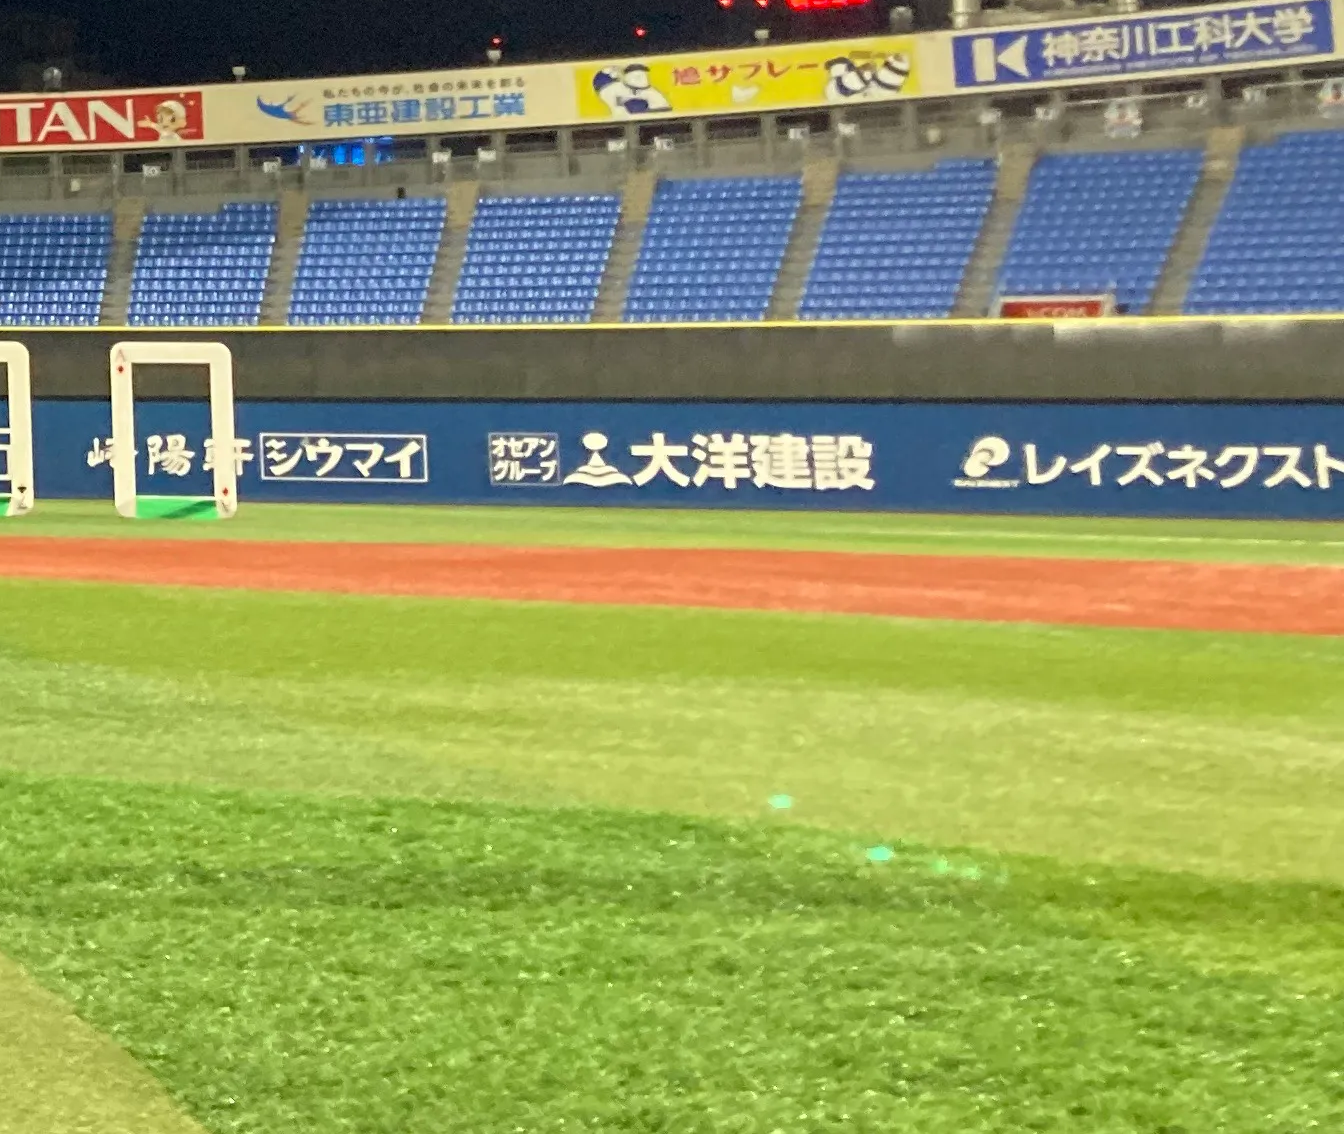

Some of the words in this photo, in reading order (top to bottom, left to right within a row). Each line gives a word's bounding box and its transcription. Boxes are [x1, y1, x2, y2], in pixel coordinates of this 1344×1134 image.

[1042, 6, 1314, 67] 神奈川工科大学
[323, 92, 526, 127] 東亜建設工業
[265, 438, 422, 477] シウマイ
[491, 436, 557, 457] オセアン
[630, 433, 875, 490] 大洋建設
[491, 459, 560, 481] グループ
